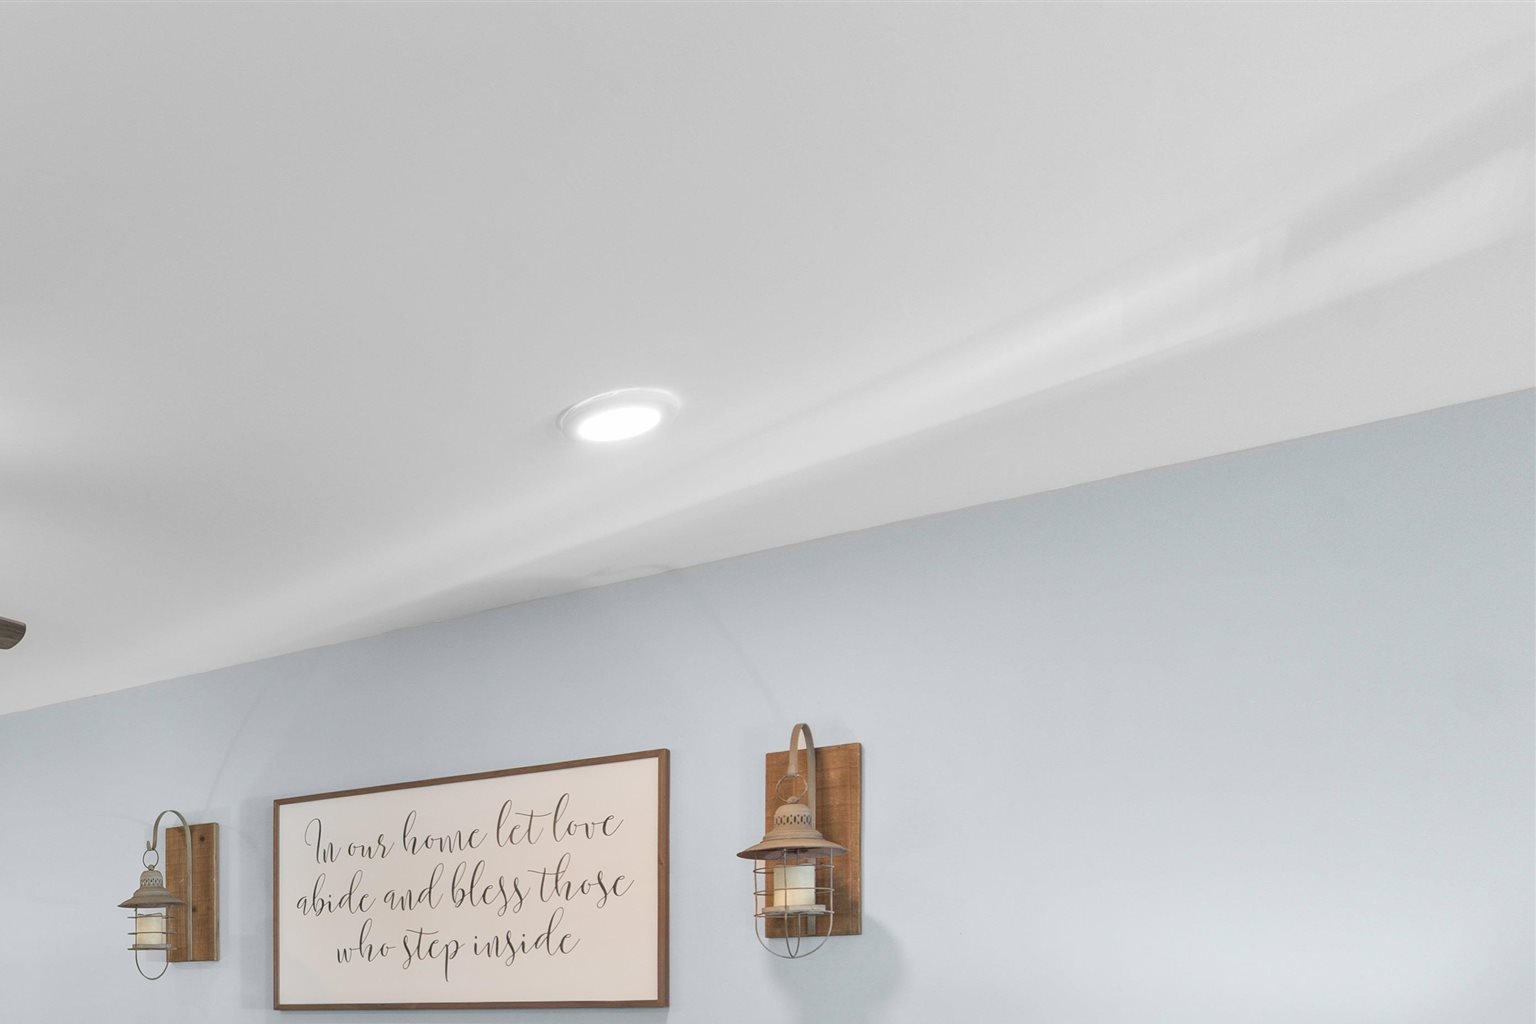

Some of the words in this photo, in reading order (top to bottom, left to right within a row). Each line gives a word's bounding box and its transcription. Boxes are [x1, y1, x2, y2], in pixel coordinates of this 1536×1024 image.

[304, 818, 342, 864] In
[347, 834, 394, 860] our
[402, 810, 488, 855] home
[496, 799, 552, 848] let
[552, 792, 624, 842] love
[296, 869, 376, 916] abide
[383, 862, 444, 911] and
[451, 859, 531, 917] bless
[527, 852, 635, 909] those
[336, 918, 396, 964] who
[402, 927, 465, 982] step
[473, 907, 581, 967] inside
